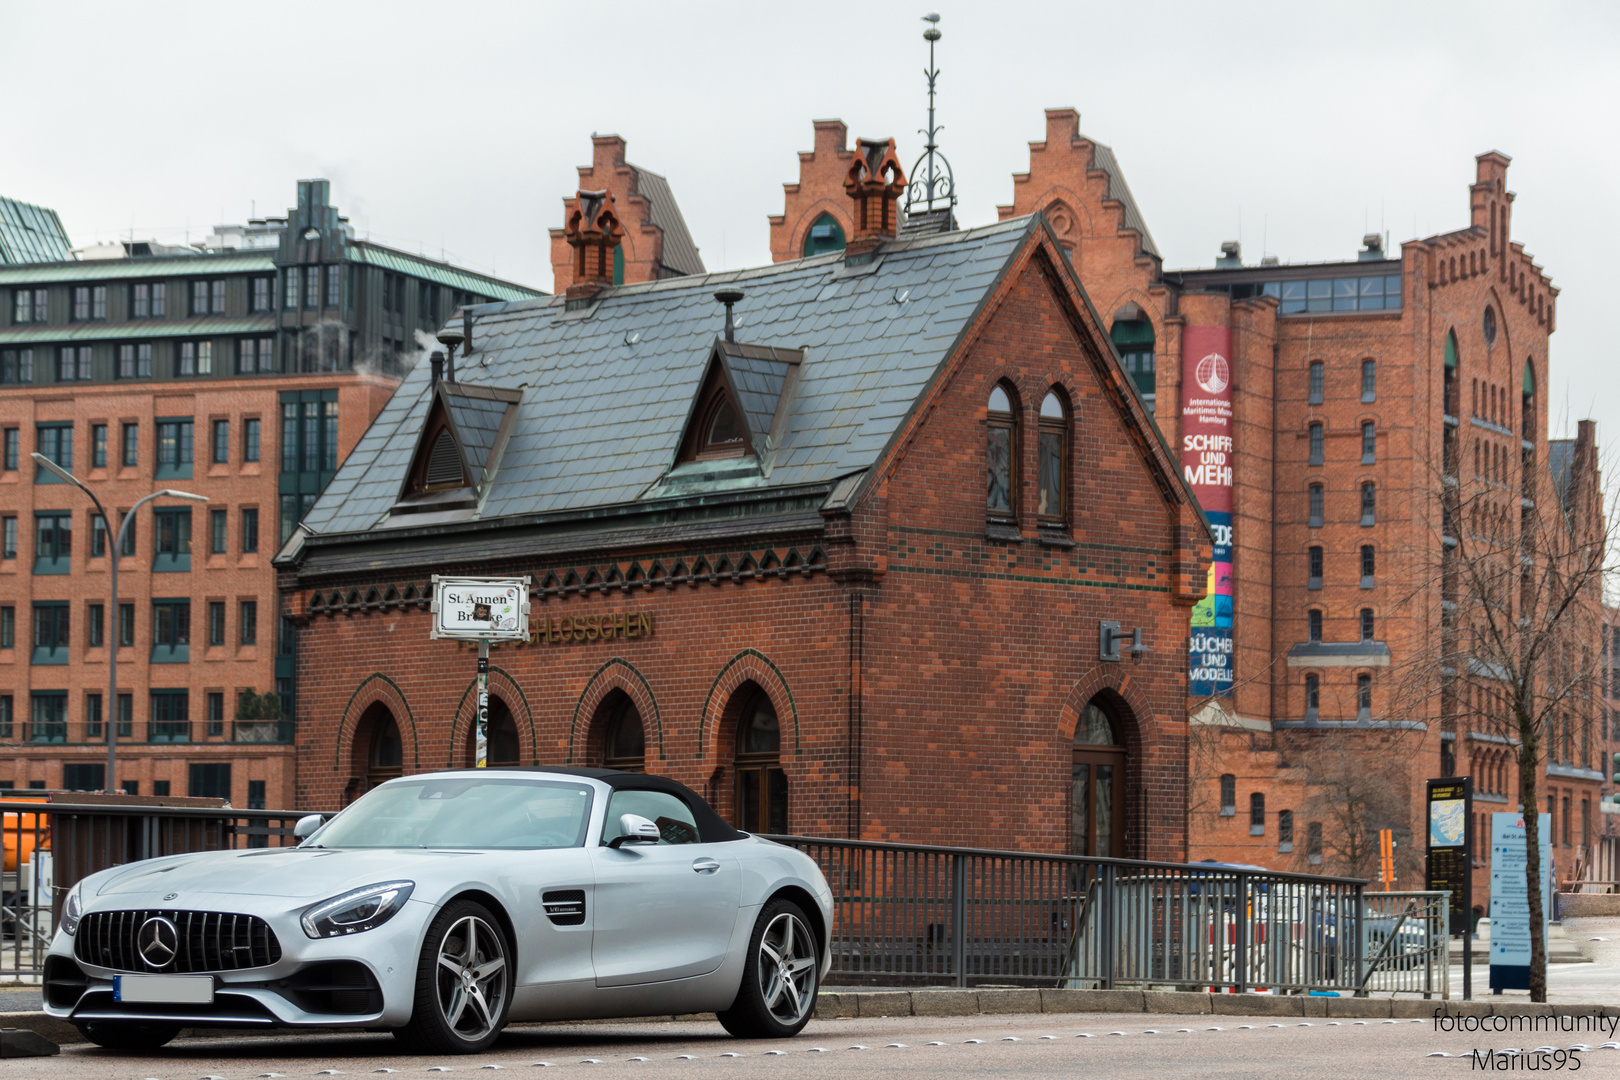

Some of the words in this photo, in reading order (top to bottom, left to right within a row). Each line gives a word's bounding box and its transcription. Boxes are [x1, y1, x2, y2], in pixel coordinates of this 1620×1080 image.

[1183, 407, 1216, 415] Maritimes
[1199, 415, 1227, 426] Hamburg
[1184, 434, 1233, 453] SCHIFFE
[1200, 452, 1226, 466] UND
[1185, 465, 1233, 487] MEHR
[448, 593, 463, 604] St.
[457, 611, 503, 622] Brke
[1202, 653, 1227, 667] UND
